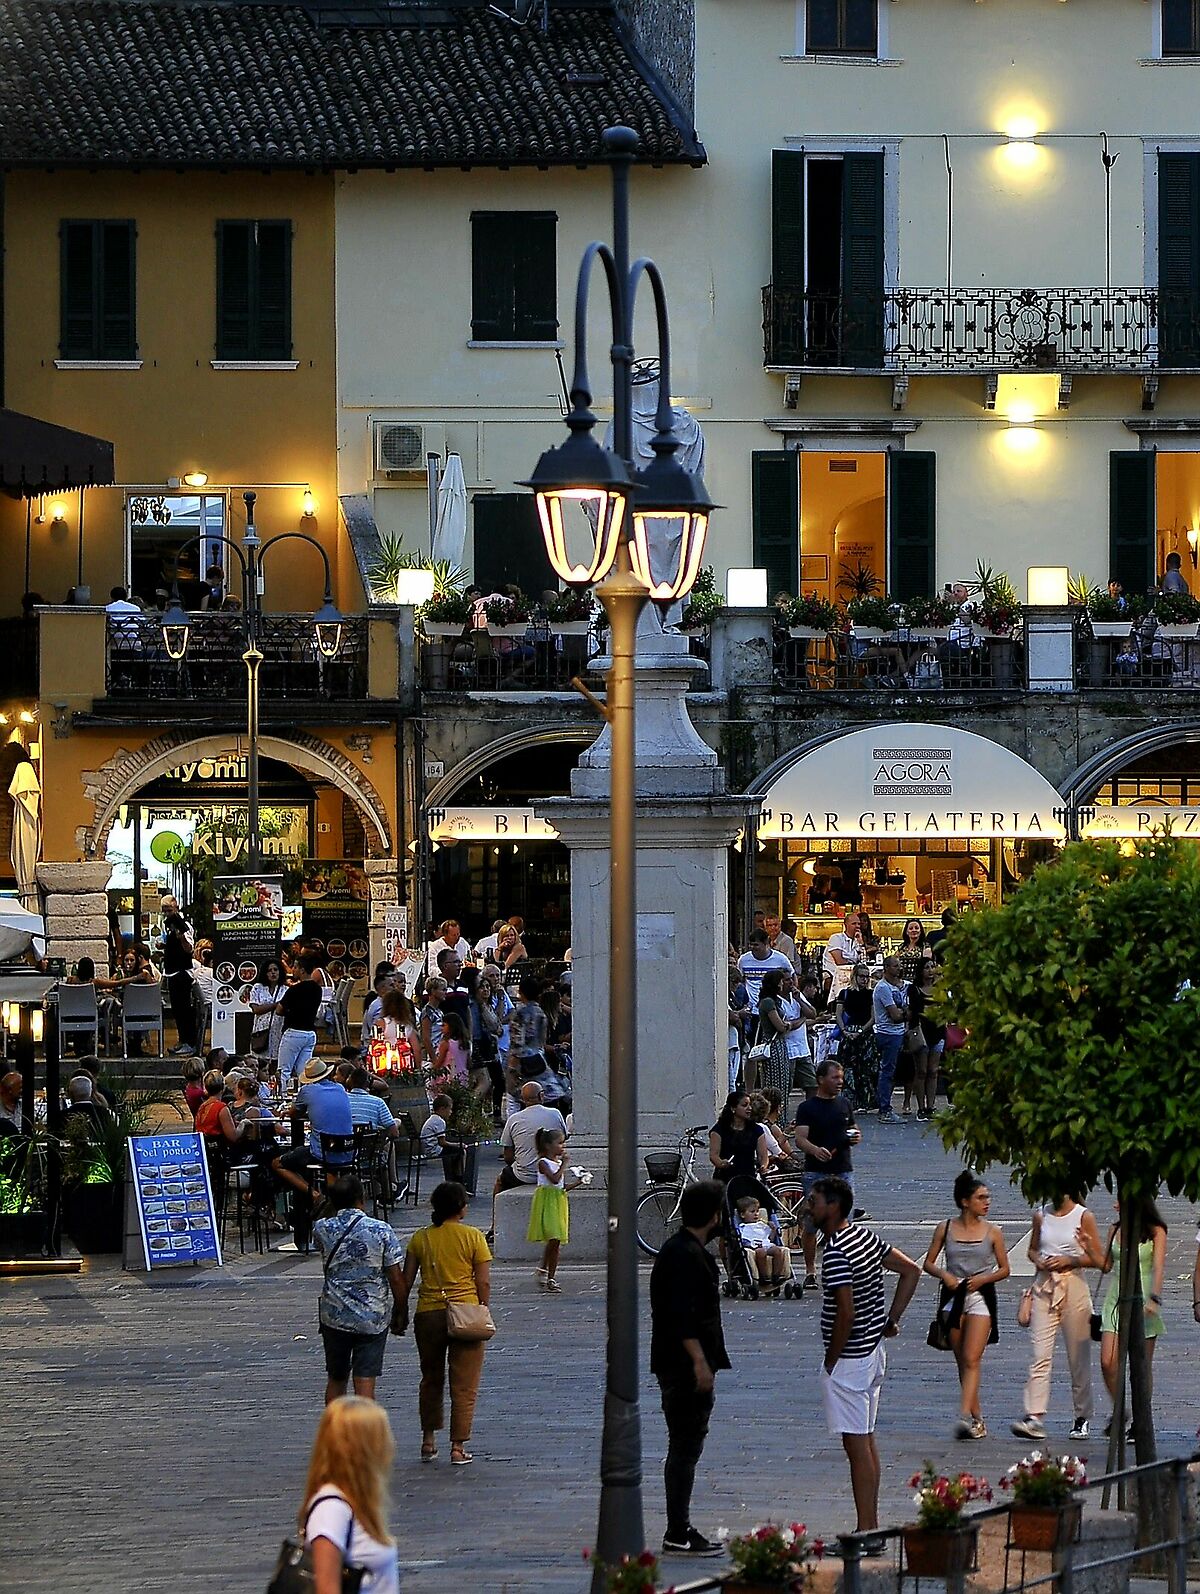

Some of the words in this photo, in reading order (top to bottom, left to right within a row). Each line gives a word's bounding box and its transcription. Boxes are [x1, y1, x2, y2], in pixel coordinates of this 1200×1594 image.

[165, 756, 246, 782] iyomi
[428, 766, 440, 774] 164
[780, 812, 839, 832] BAR
[859, 812, 1043, 832] GELATERIA
[386, 929, 406, 939] BAR
[152, 1140, 181, 1148] BAR
[142, 1148, 158, 1157] del
